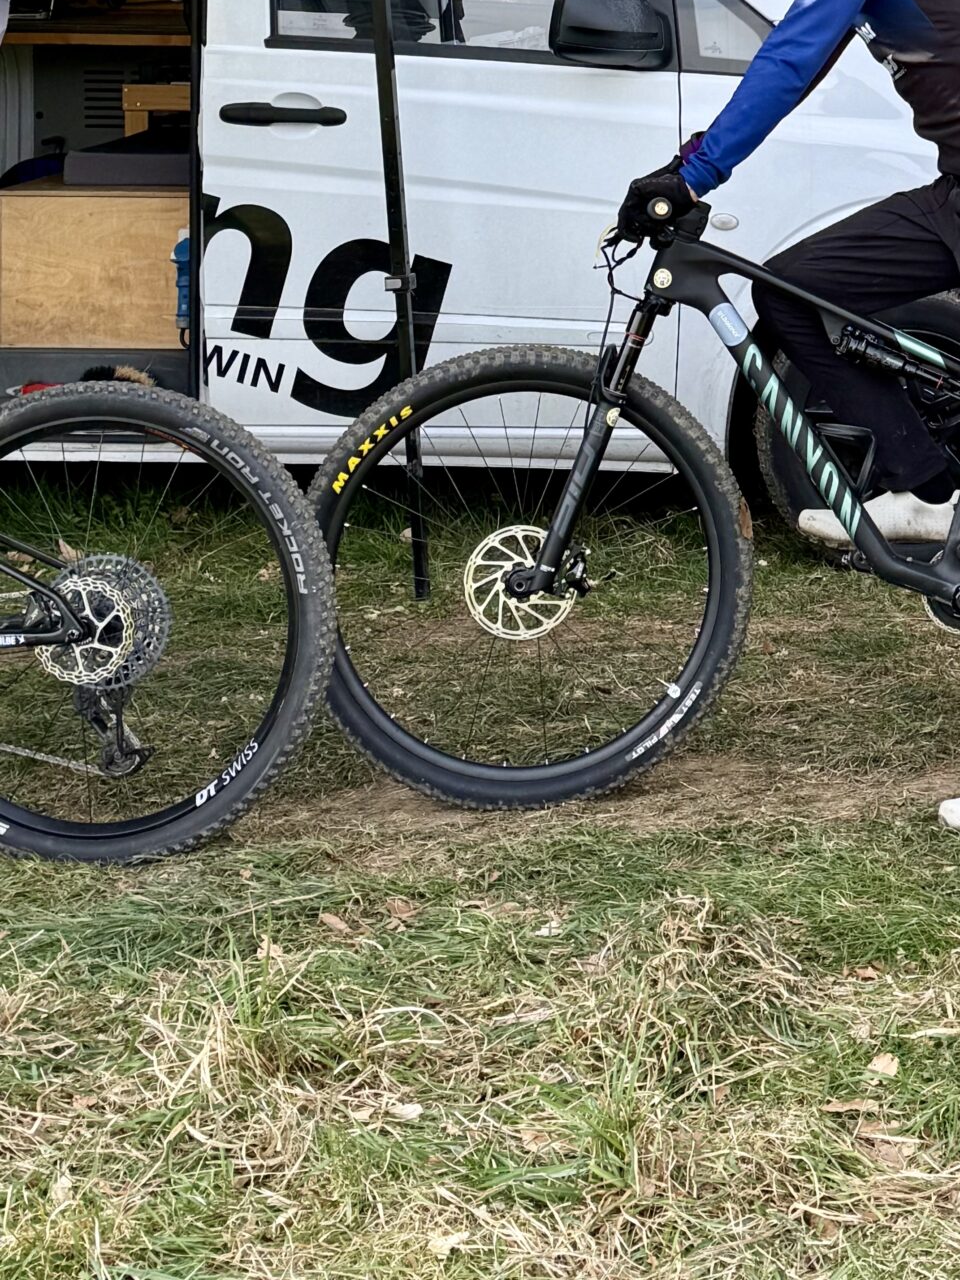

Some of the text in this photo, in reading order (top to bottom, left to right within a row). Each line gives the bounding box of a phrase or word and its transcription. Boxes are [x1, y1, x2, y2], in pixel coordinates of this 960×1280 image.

[202, 193, 453, 418] ng
[206, 344, 286, 394] WIN
[332, 405, 412, 495] MAXXIS
[743, 343, 862, 542] CANYON
[195, 737, 259, 807] DT SWISS
